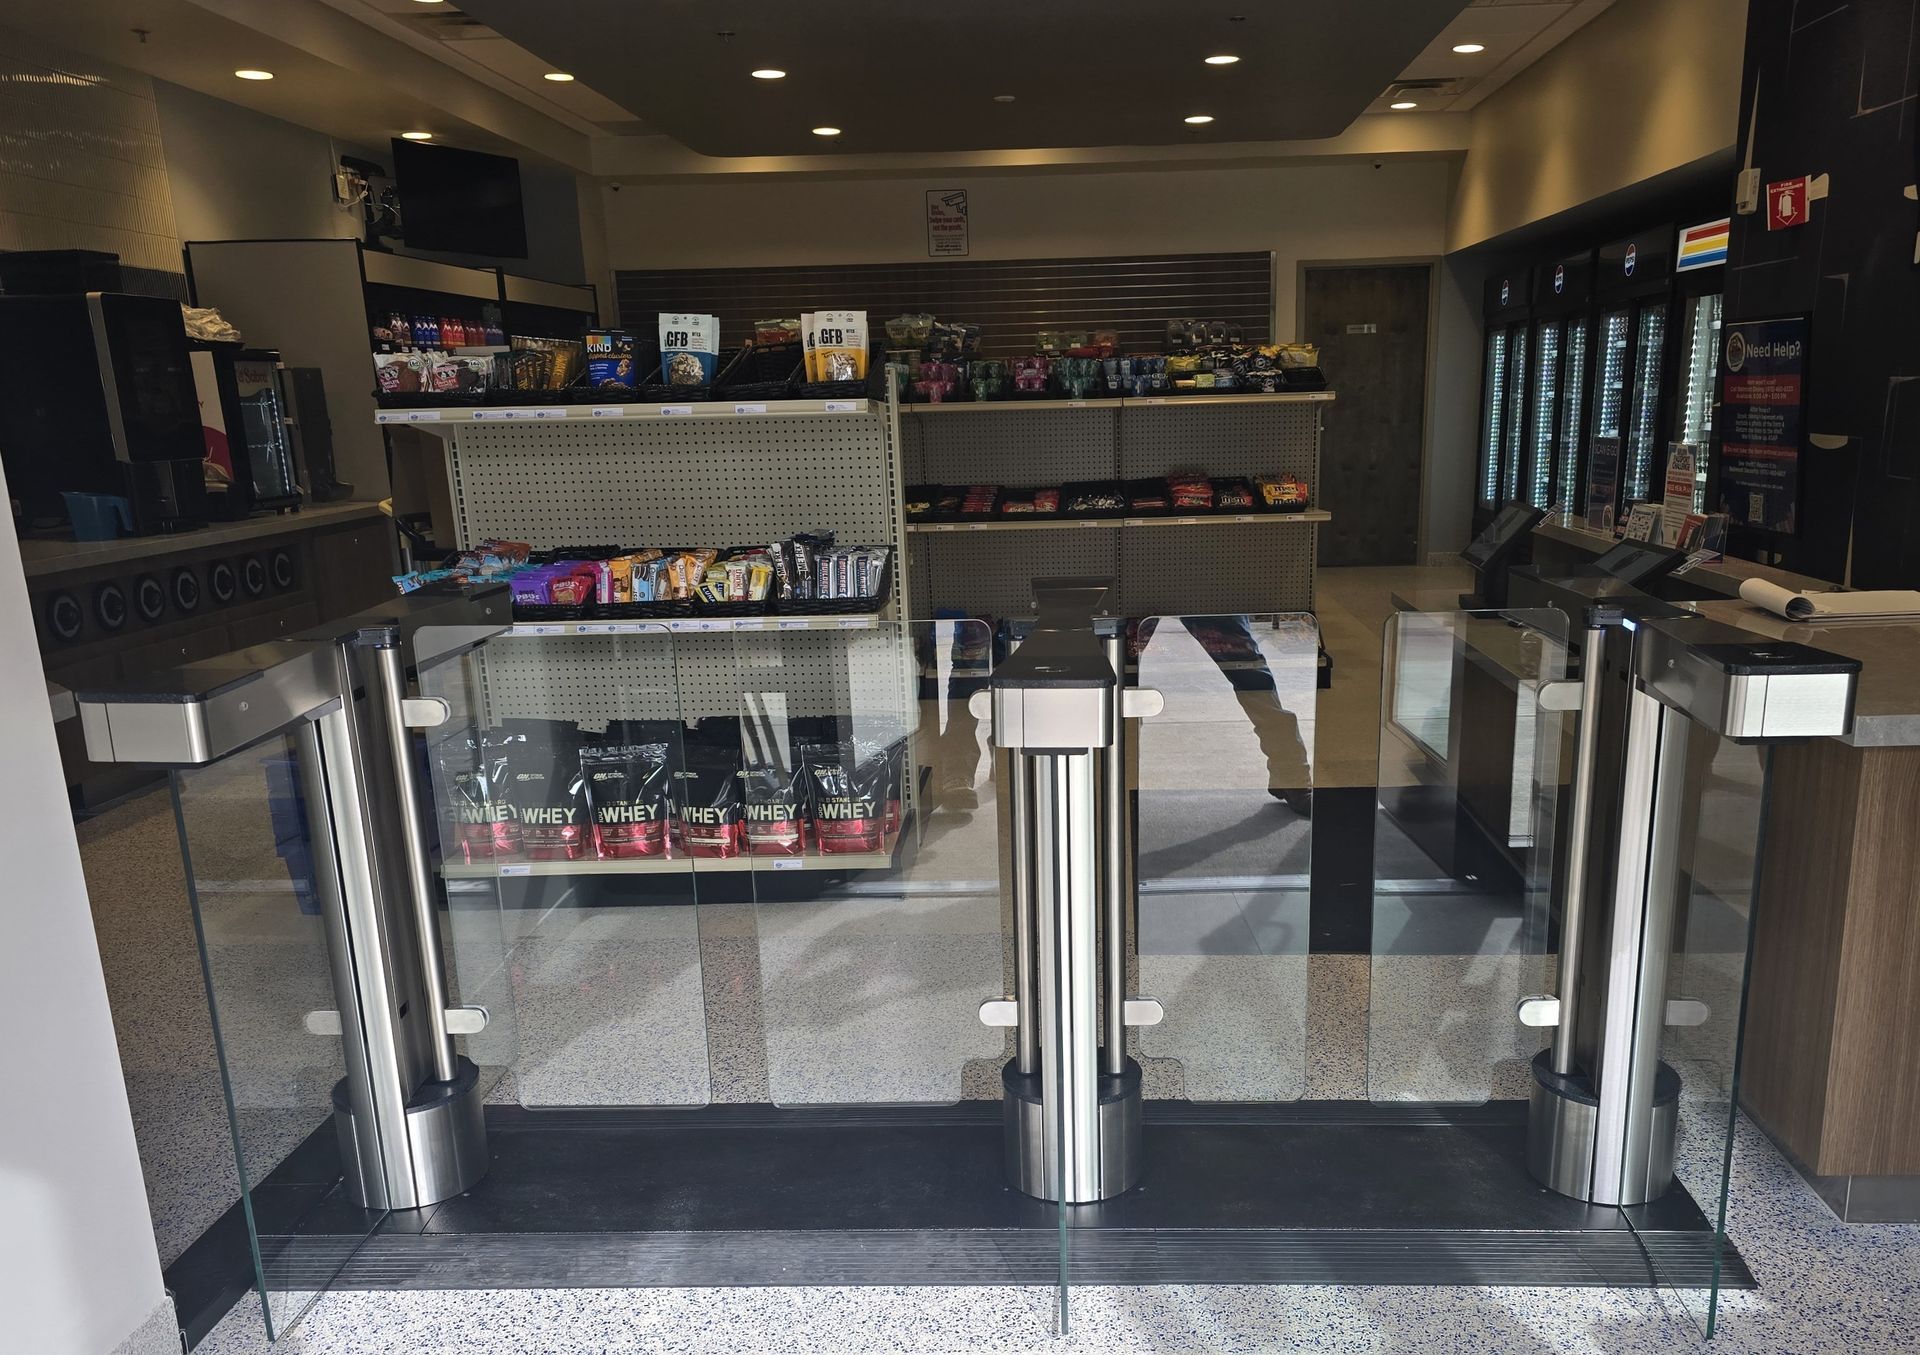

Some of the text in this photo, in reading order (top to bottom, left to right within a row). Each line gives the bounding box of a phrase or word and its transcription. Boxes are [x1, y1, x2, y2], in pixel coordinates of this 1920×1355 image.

[666, 331, 688, 347] GFB
[821, 328, 843, 345] GFB
[586, 343, 612, 353] KIND
[1746, 340, 1801, 359] Need Help?
[701, 586, 715, 603] LUNA
[464, 803, 519, 824] WHEY
[522, 807, 577, 824] WHEY
[602, 803, 659, 823] WHEY
[680, 806, 728, 824] WHEY
[746, 803, 797, 821] WHEY
[822, 801, 876, 820] WHEY
